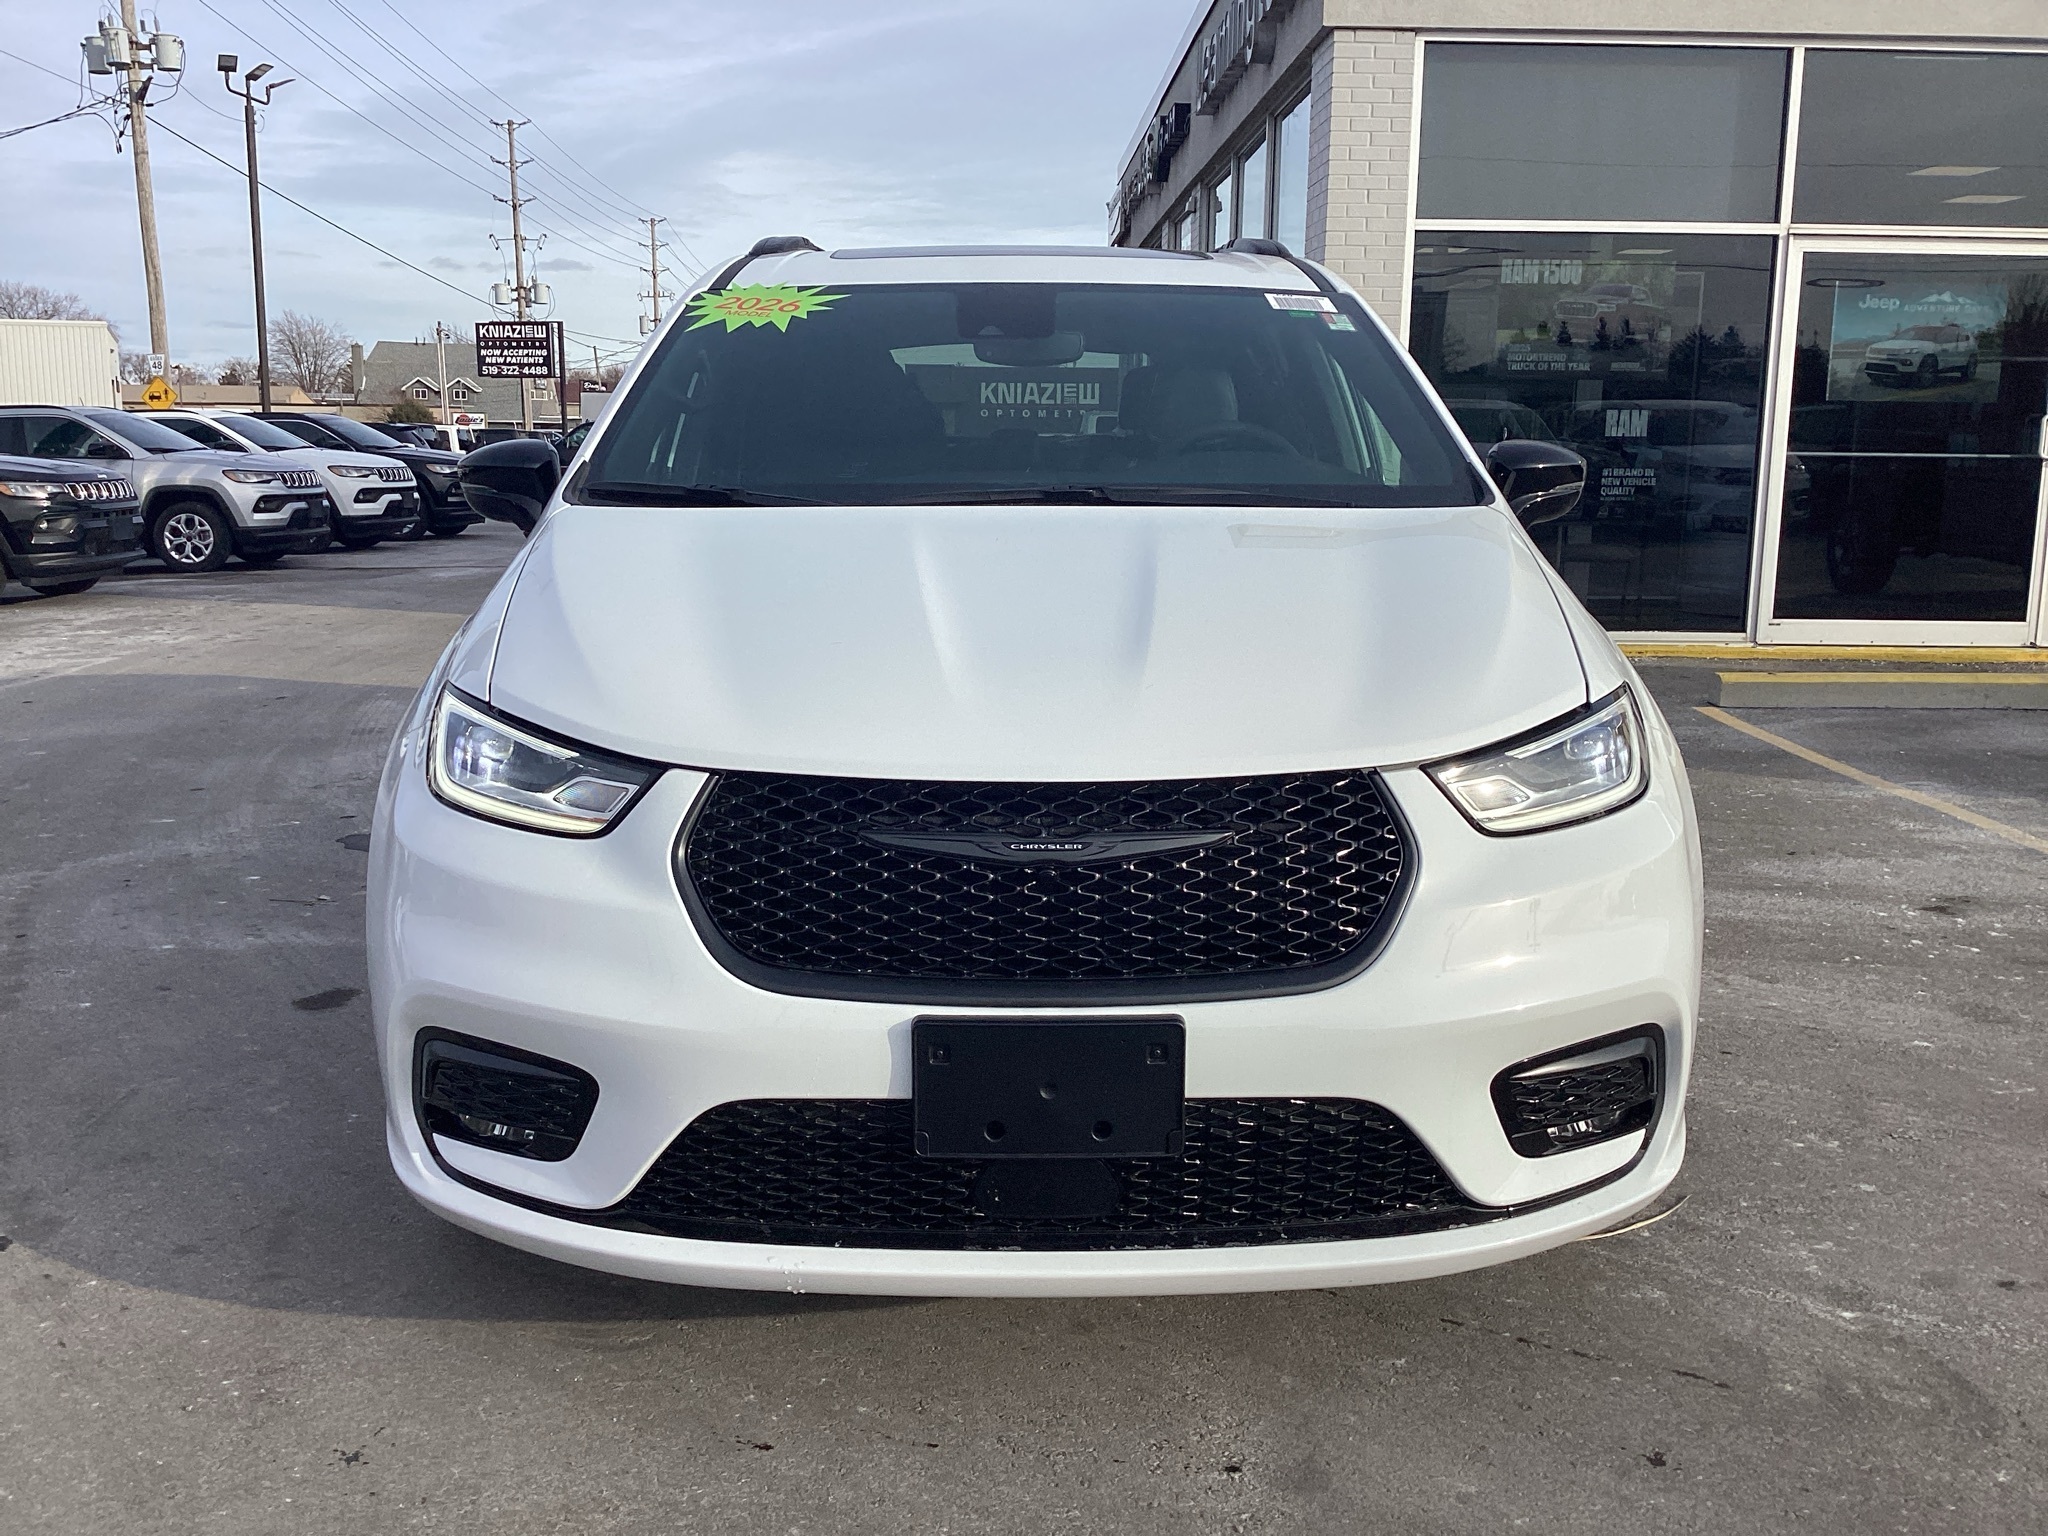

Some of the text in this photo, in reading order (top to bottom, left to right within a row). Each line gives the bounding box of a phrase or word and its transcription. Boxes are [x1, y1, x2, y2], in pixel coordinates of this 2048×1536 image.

[1501, 258, 1582, 285] RAM 1500
[713, 296, 801, 313] 2026
[1859, 294, 1900, 311] Jeep
[724, 309, 772, 318] MODEL
[1904, 304, 1961, 313] ADVENTURE
[479, 325, 547, 338] KNIAZIEW
[1507, 352, 1567, 362] MOTORTREND
[152, 361, 163, 370] 48
[481, 366, 549, 375] 519-322-4488
[1507, 361, 1591, 372] TRUCK OF THE YEAR
[980, 382, 1100, 404] KNIAZIEW
[1604, 409, 1649, 437] RAM
[1602, 467, 1655, 477] #1 BRAND IN
[1601, 477, 1656, 486] NEW VEHICLE
[1600, 486, 1635, 496] QUALITY
